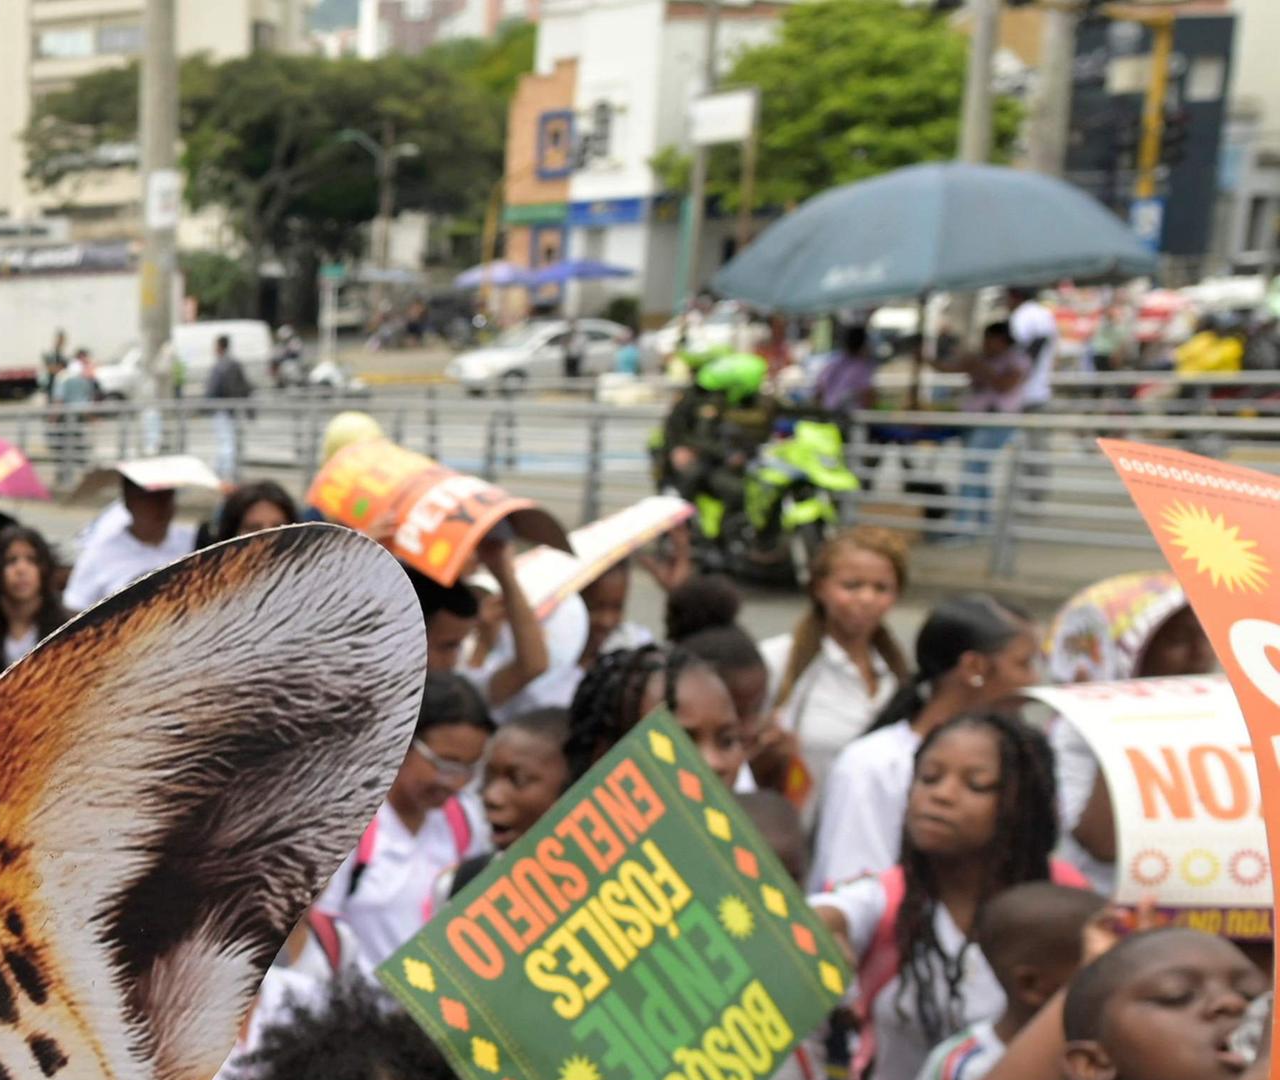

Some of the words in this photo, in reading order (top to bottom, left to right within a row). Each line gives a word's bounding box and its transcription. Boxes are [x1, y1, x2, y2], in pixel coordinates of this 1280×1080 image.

[552, 800, 626, 874] EL
[593, 758, 667, 844] EN
[446, 836, 589, 980] SUELO
[525, 839, 693, 1019] FÓSILES
[648, 900, 751, 1024] EN
